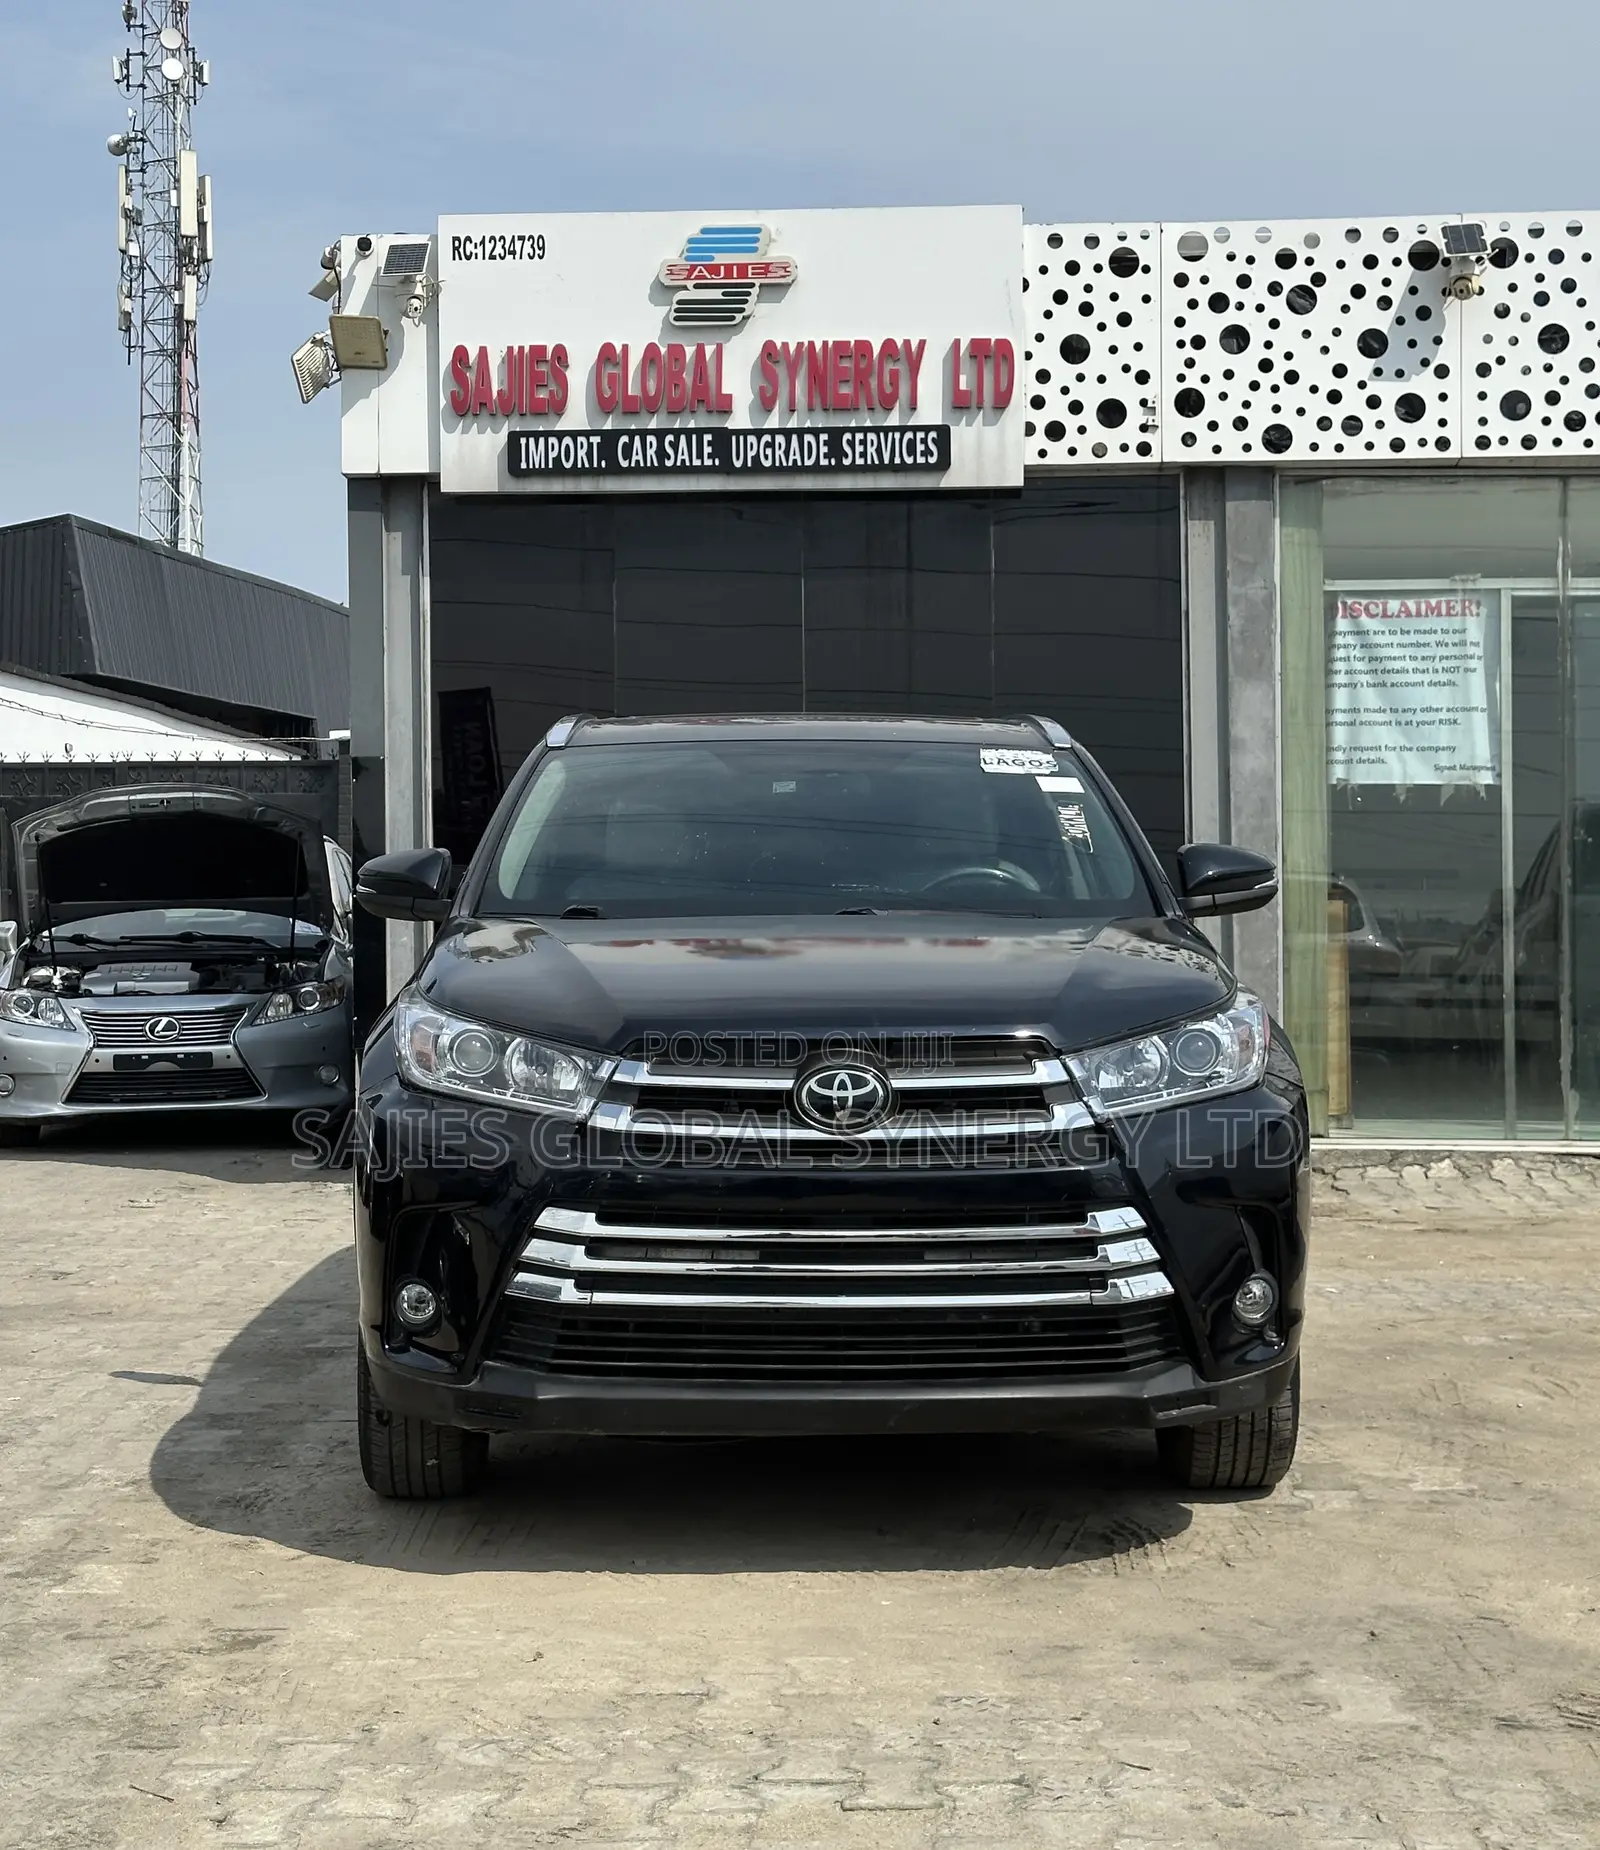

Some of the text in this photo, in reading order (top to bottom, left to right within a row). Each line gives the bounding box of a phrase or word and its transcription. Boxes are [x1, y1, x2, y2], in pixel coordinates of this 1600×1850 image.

[451, 234, 546, 261] RC:1234739
[665, 262, 792, 280] SAJIES
[450, 337, 1015, 416] SAJIES GLOBAL SYNERGY LTD
[519, 430, 939, 470] IMPORT. CAR SALE. UPGRADE. SERVICES
[1400, 628, 1411, 636] be
[1413, 627, 1438, 635] made
[1329, 643, 1358, 651] mpany
[1396, 640, 1432, 648] number.
[1435, 639, 1449, 648] We
[1451, 639, 1467, 647] will
[1329, 655, 1351, 664] quest
[1353, 654, 1366, 662] for
[1368, 655, 1406, 663] payment
[1420, 655, 1436, 663] any
[1439, 653, 1475, 662] personal
[1328, 667, 1342, 675] her
[1380, 667, 1409, 675] details
[1412, 666, 1430, 674] that
[1432, 666, 1439, 674] is
[1441, 666, 1461, 674] NOT
[1327, 679, 1459, 689] mpany's bank account details.
[1326, 706, 1360, 715] ayments
[1363, 705, 1387, 714] made
[1401, 707, 1417, 715] any
[1419, 705, 1444, 713] other
[1326, 718, 1356, 728] ersonal
[1415, 720, 1436, 728] your
[1438, 718, 1461, 726] RISK.
[1349, 745, 1382, 753] request
[1384, 744, 1397, 752] for
[1400, 744, 1414, 752] the
[1416, 745, 1457, 753] company
[982, 757, 1057, 768] LAGOS
[1356, 757, 1388, 765] details.
